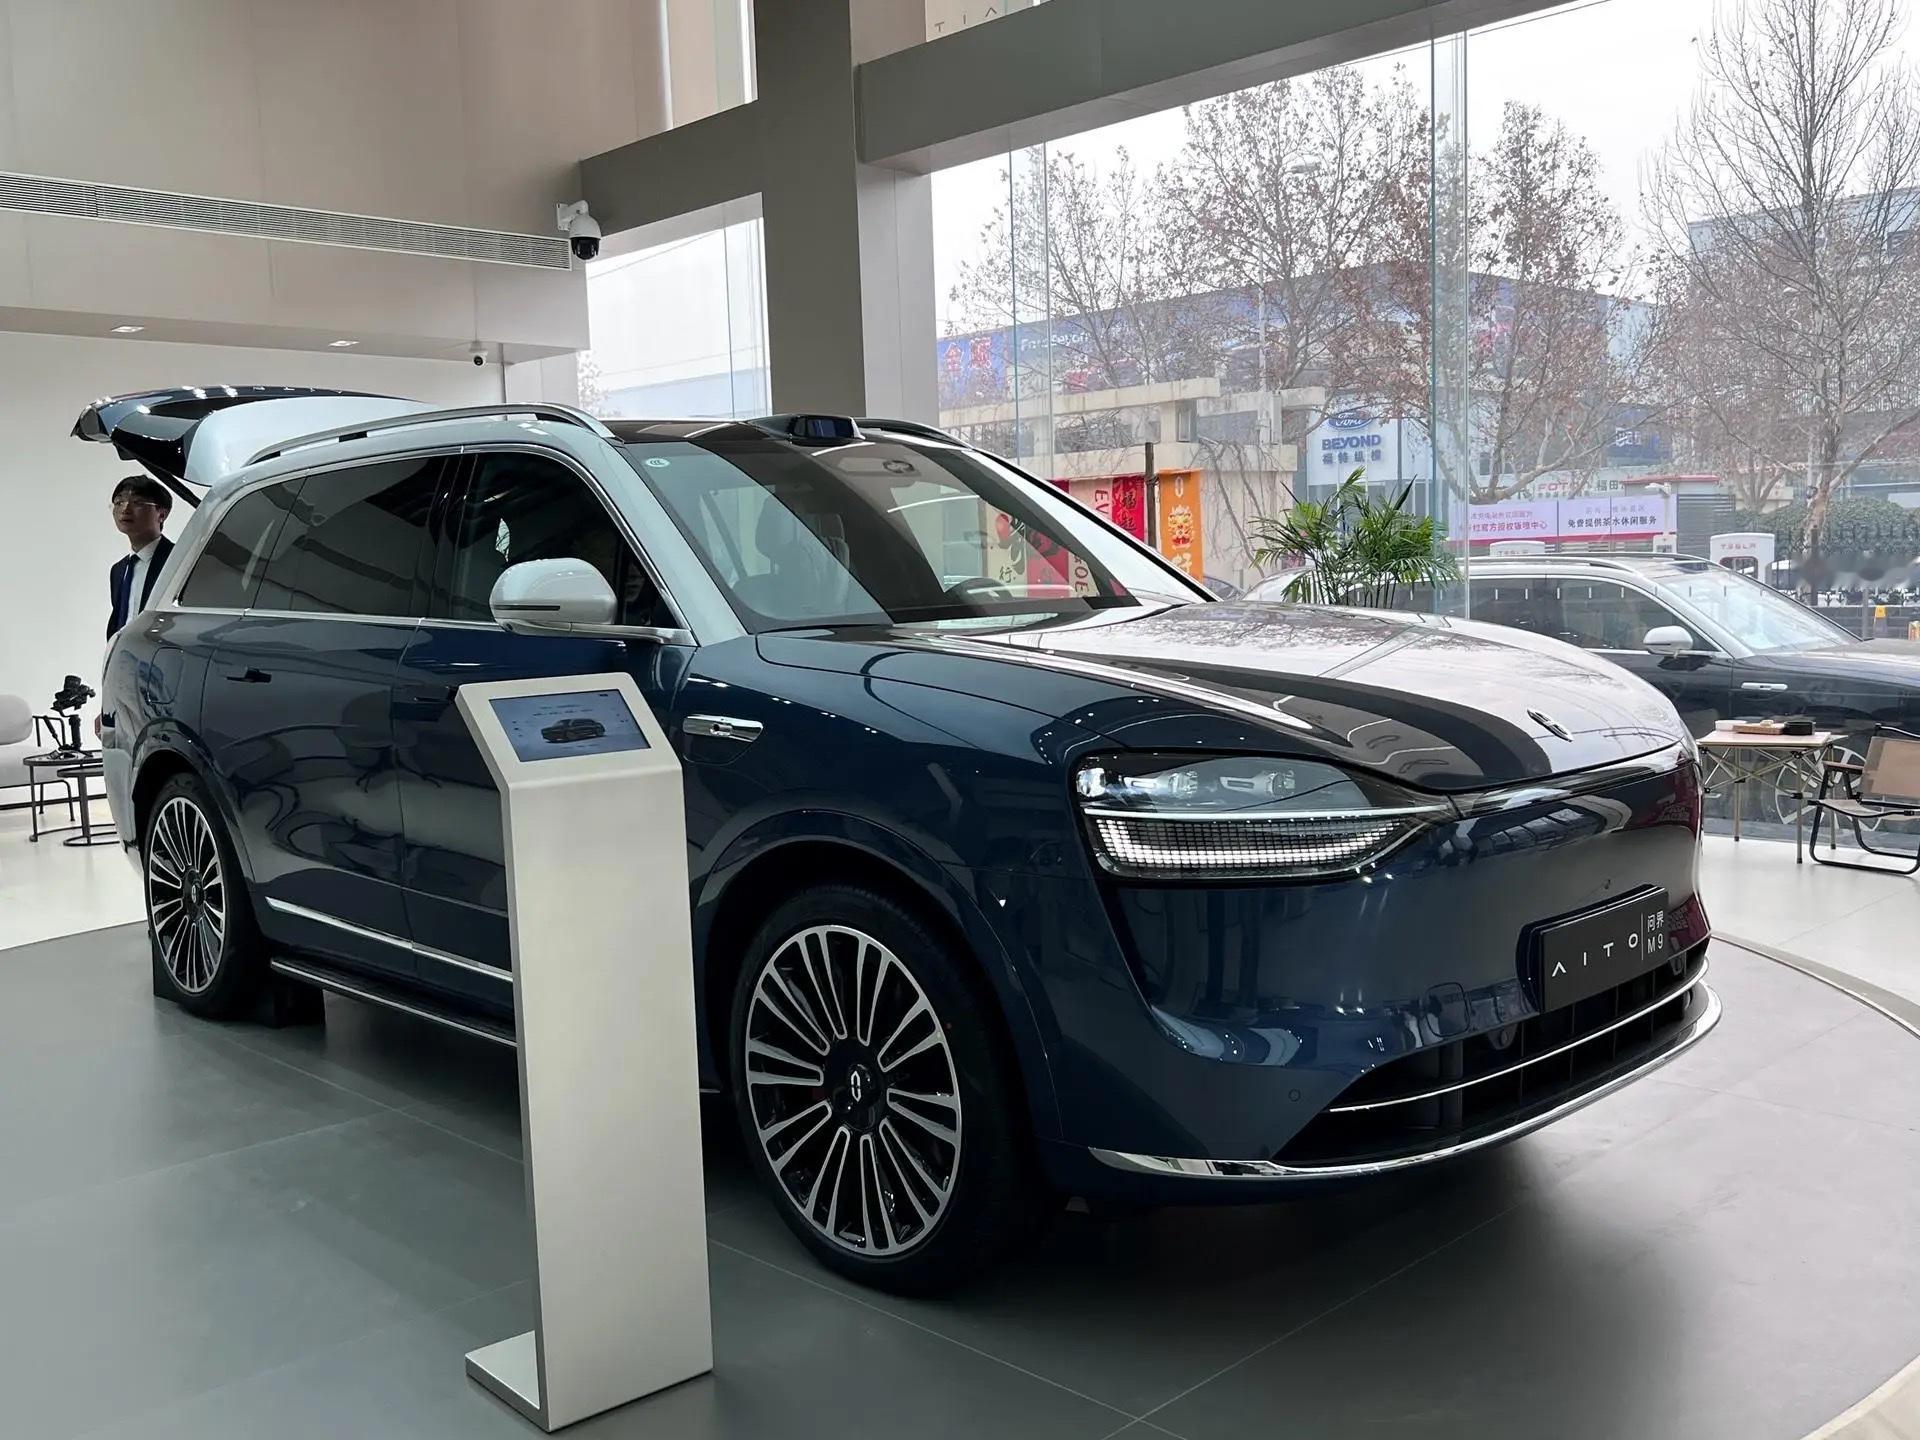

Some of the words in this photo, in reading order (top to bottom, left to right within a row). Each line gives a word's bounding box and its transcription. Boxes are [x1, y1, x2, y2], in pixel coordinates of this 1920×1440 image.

[1322, 434, 1382, 450] BEYOND
[1597, 479, 1624, 492] 福田
[1567, 515, 1657, 528] 免费提供茶水休闲服务
[1647, 910, 1665, 933] 问界
[1647, 933, 1664, 954] M9
[1551, 933, 1639, 977] AITO
